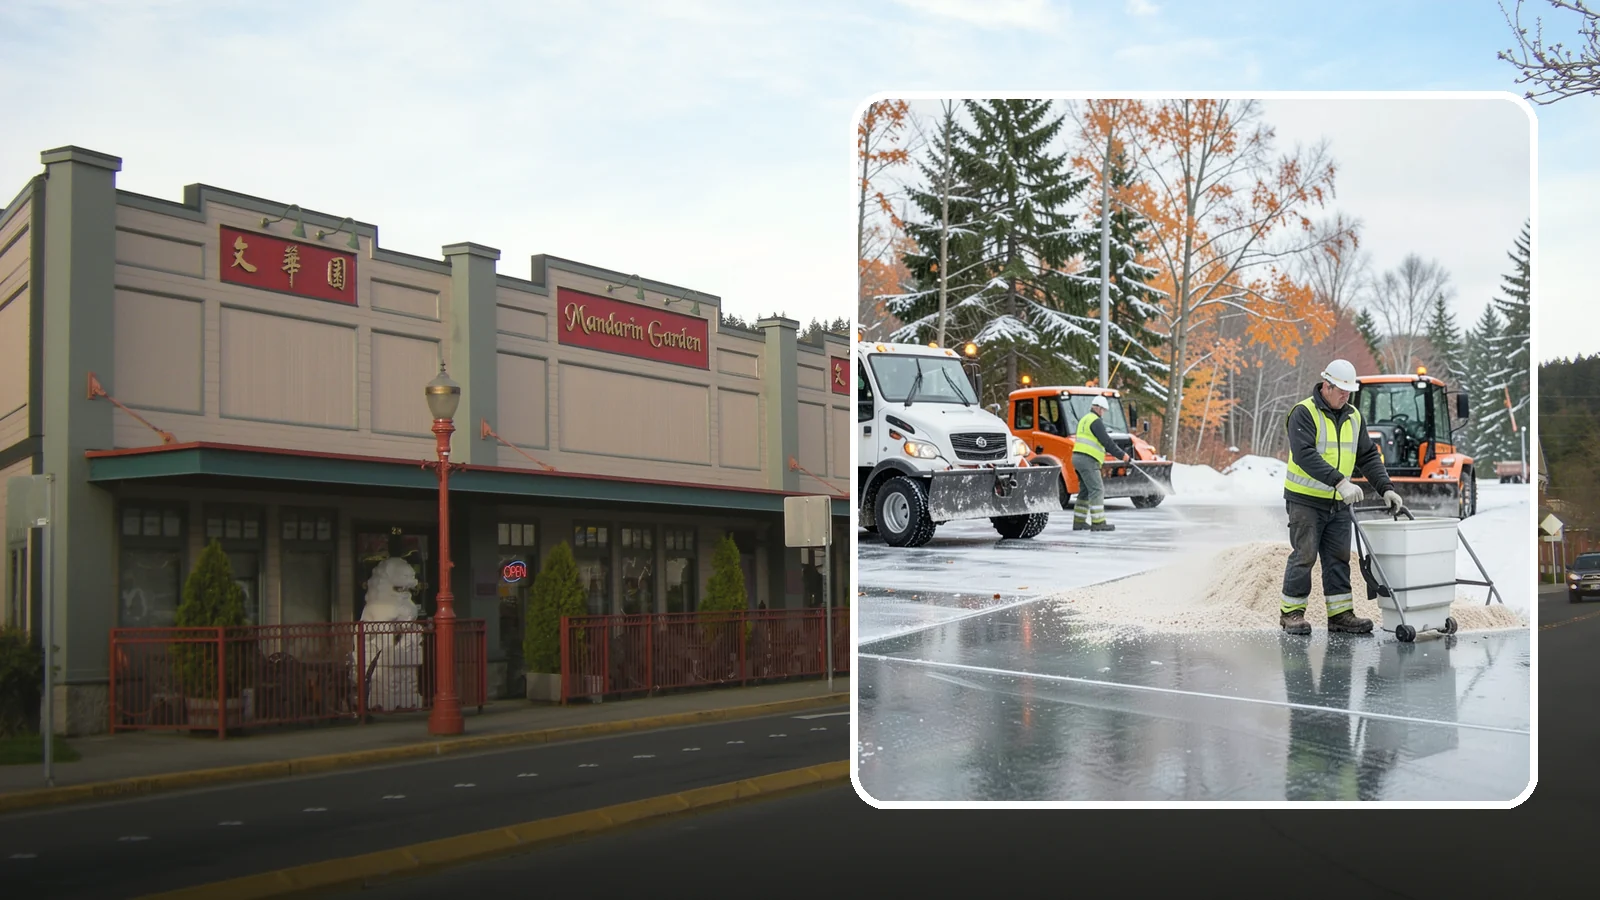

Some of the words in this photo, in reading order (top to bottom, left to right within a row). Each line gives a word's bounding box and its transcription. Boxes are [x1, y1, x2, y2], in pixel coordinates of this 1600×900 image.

[231, 236, 346, 291] 文華園
[565, 302, 644, 341] Mandarin
[648, 320, 701, 352] Garden
[503, 565, 527, 578] OPEN
